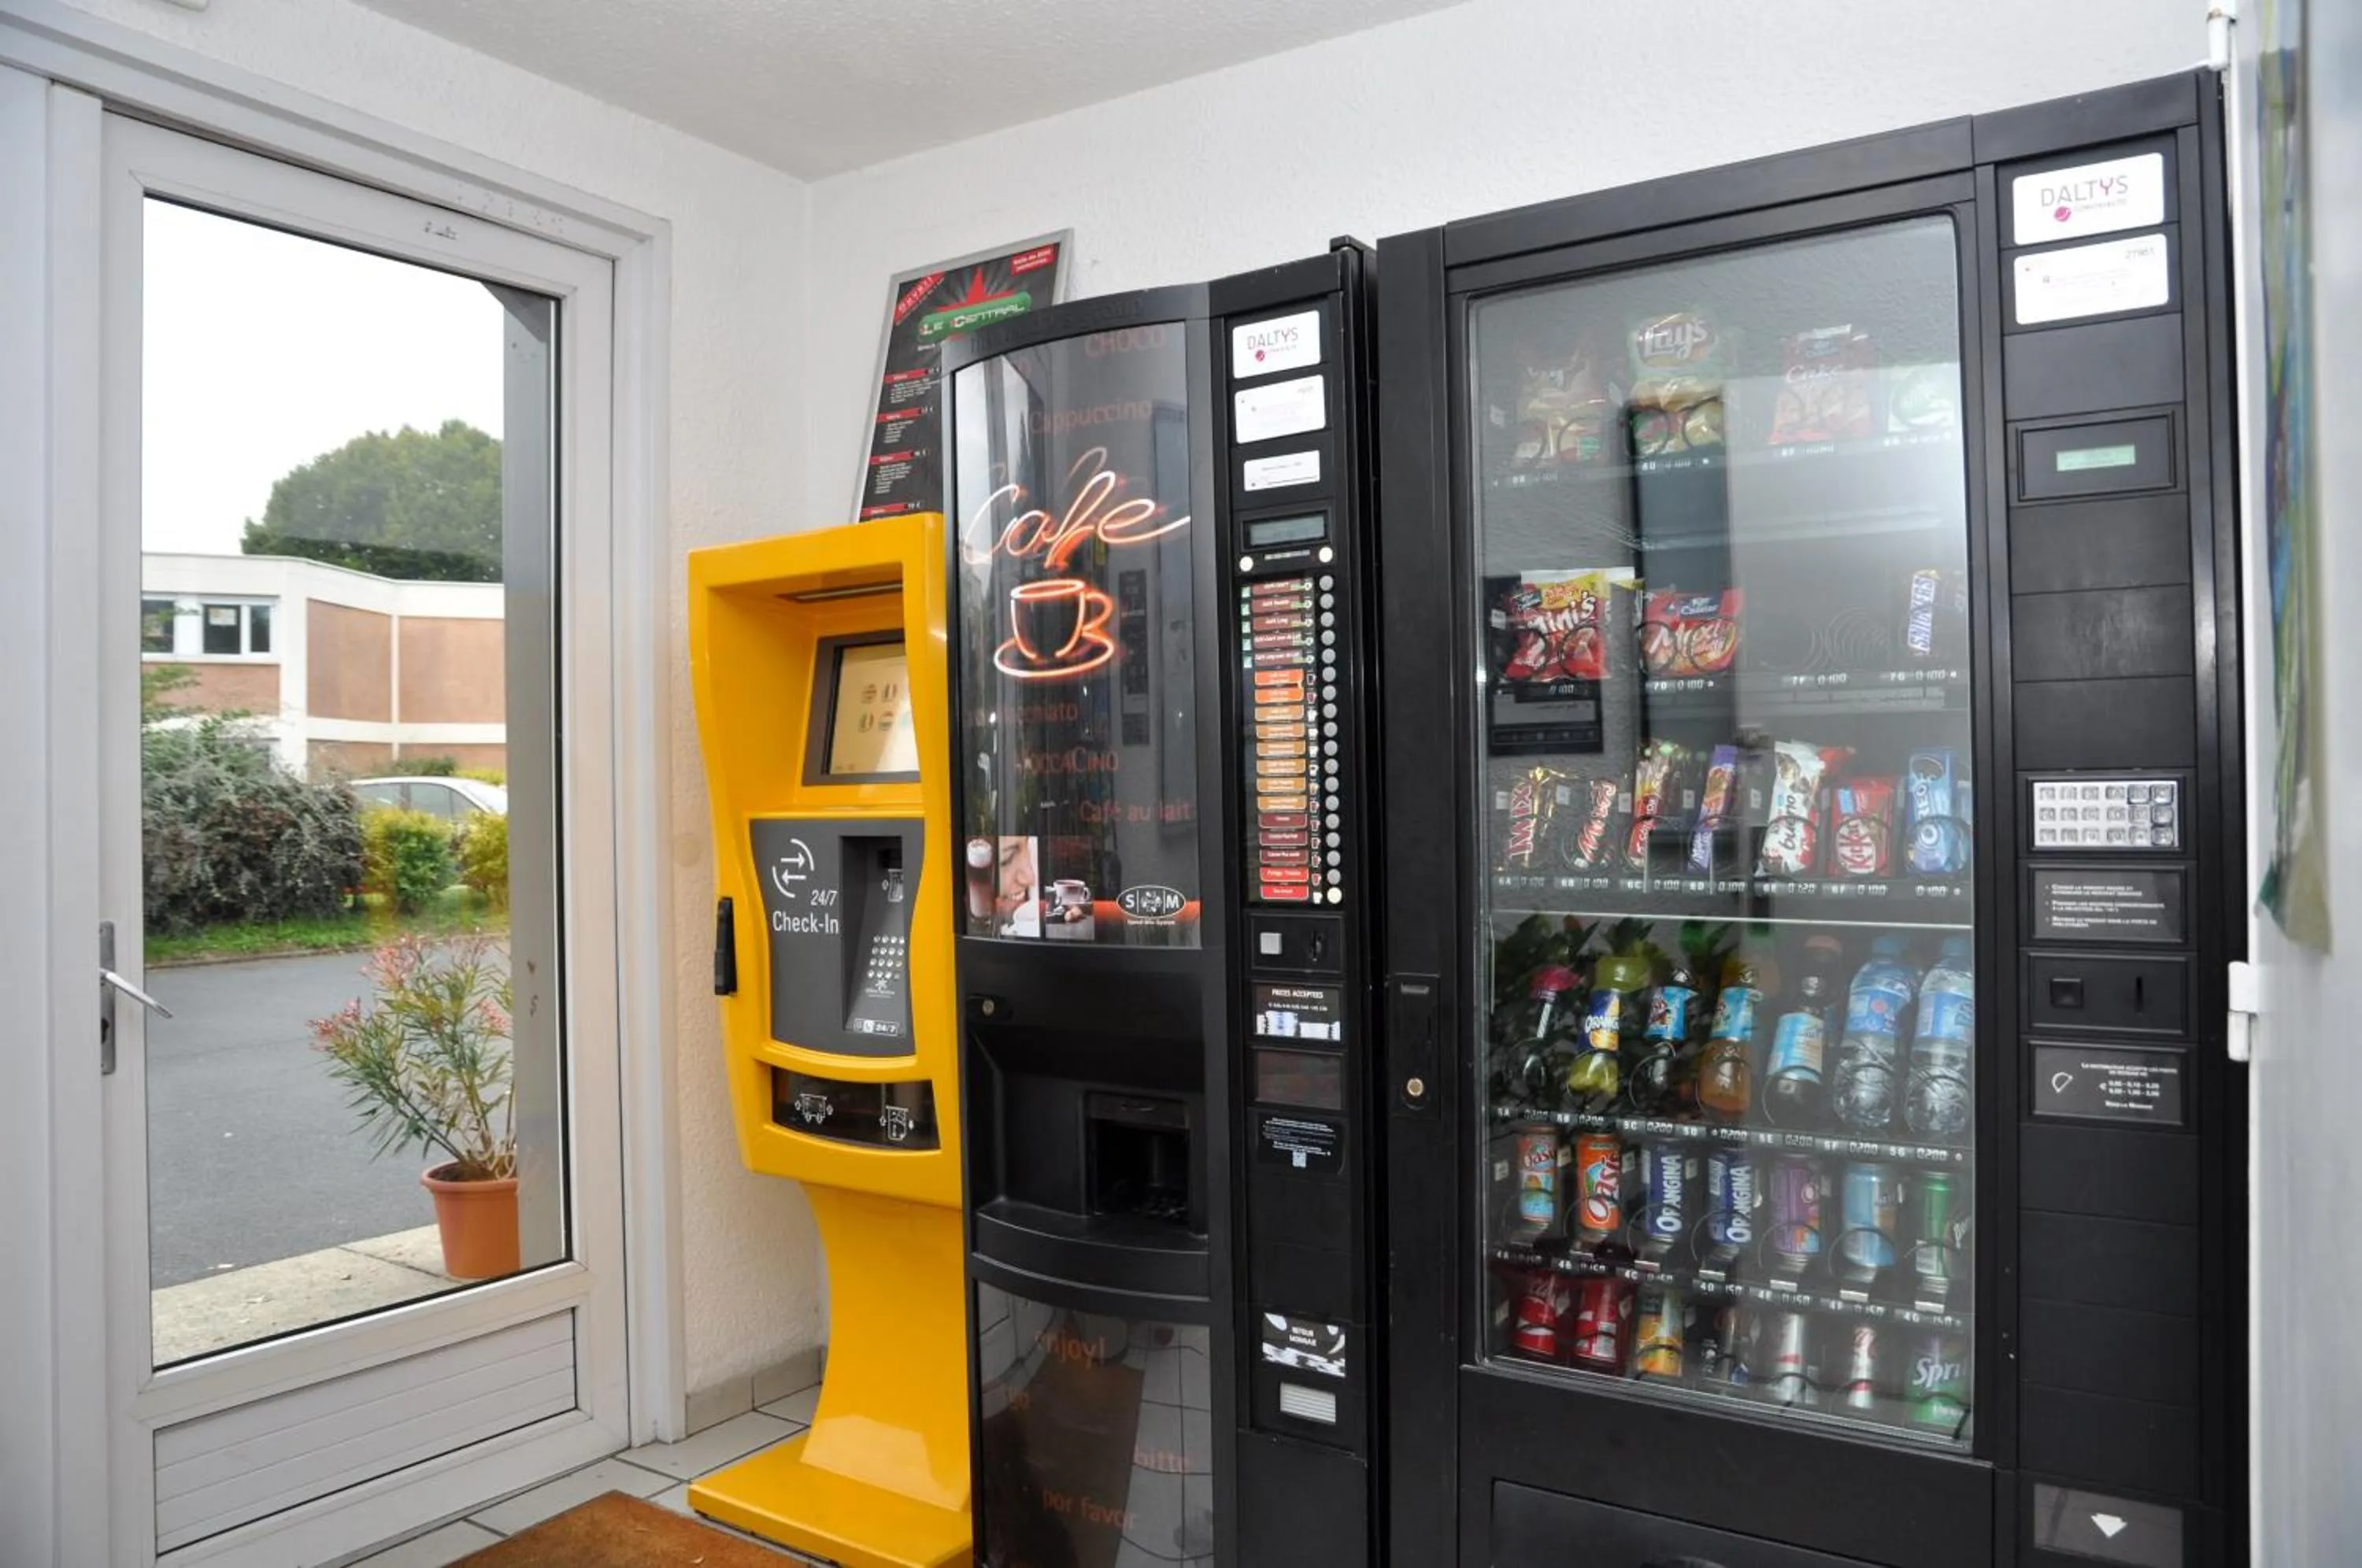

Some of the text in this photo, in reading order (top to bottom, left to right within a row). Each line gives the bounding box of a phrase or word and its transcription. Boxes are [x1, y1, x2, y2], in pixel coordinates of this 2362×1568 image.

[2041, 175, 2129, 207] DALTYS
[920, 321, 944, 335] LE
[1247, 327, 1299, 350] DALTYS
[1029, 400, 1153, 435] Cappuccino
[1908, 575, 1934, 652] SNICKERS
[1079, 799, 1194, 823] Café au lait
[1779, 794, 1798, 851] bueno
[810, 889, 839, 906] 24/7
[772, 911, 840, 934] Check-In
[1042, 1489, 1137, 1529] por favor
